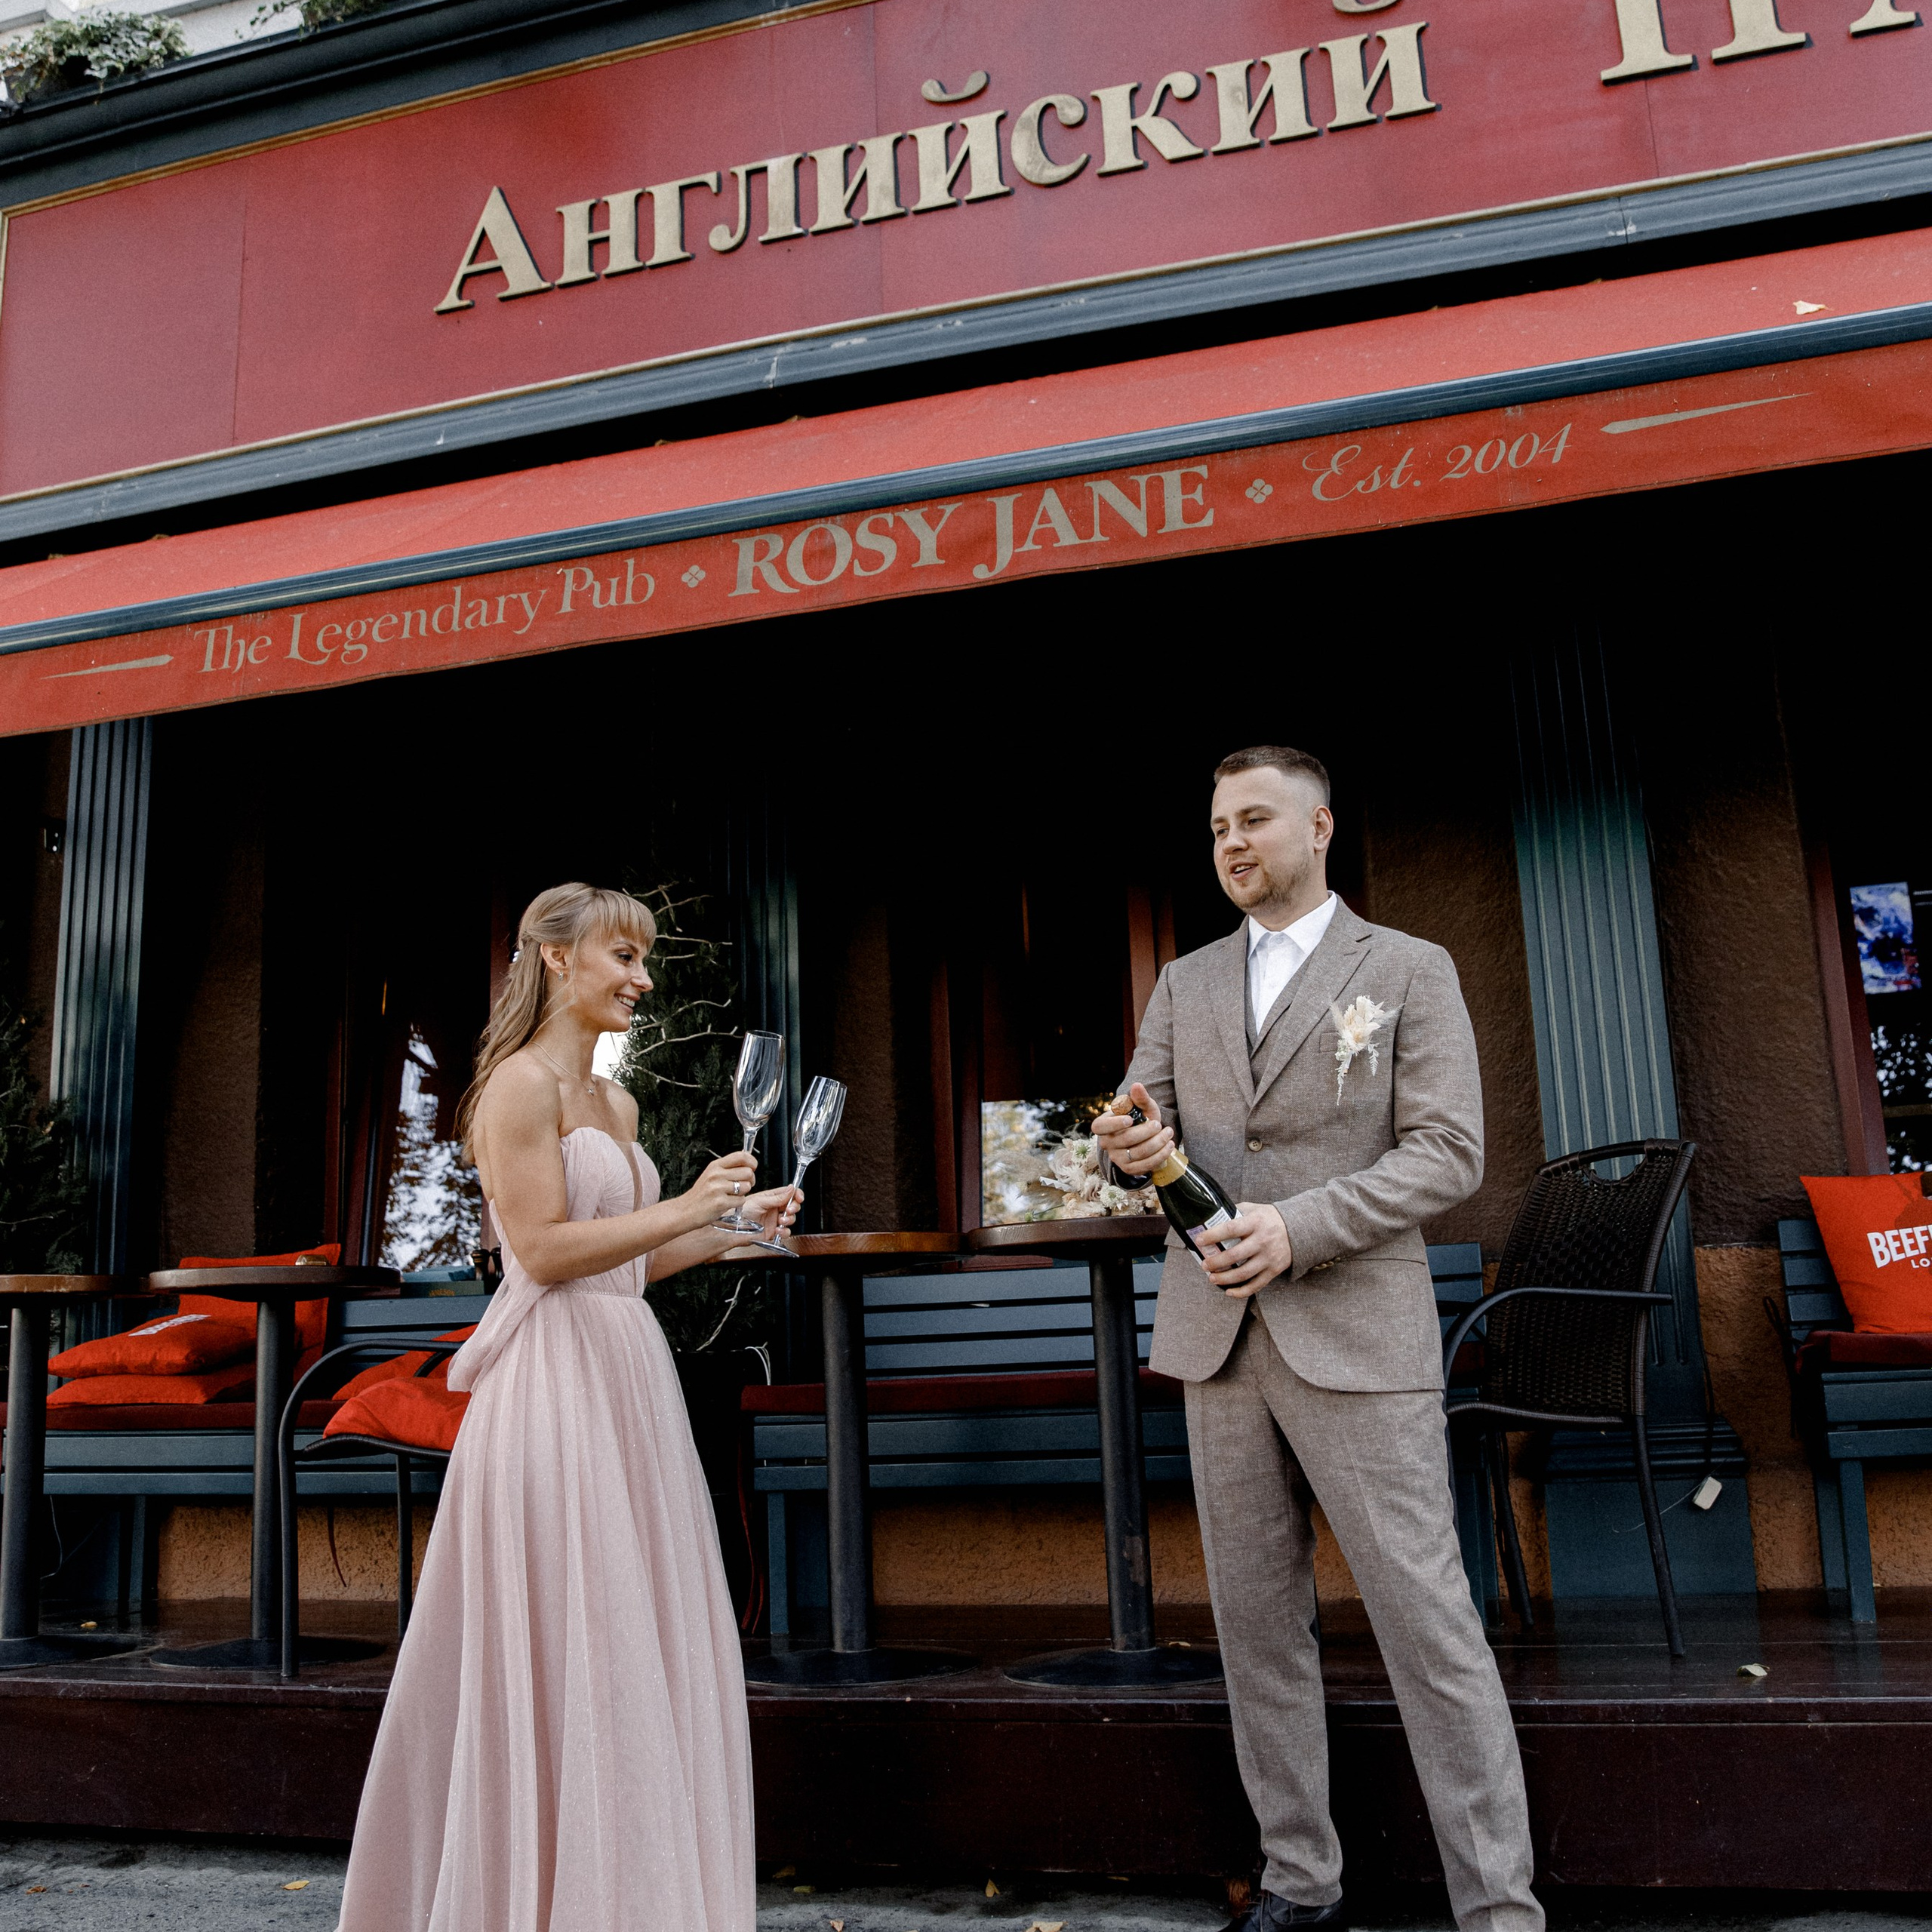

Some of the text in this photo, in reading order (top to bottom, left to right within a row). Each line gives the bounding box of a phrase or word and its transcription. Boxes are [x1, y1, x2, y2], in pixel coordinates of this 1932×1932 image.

[435, 0, 1441, 314] Английский
[194, 423, 1572, 673] The Legendary Pub ROSY JANE Est. 2004
[1866, 1224, 1932, 1269] BEEF
[1910, 1257, 1932, 1269] LO
